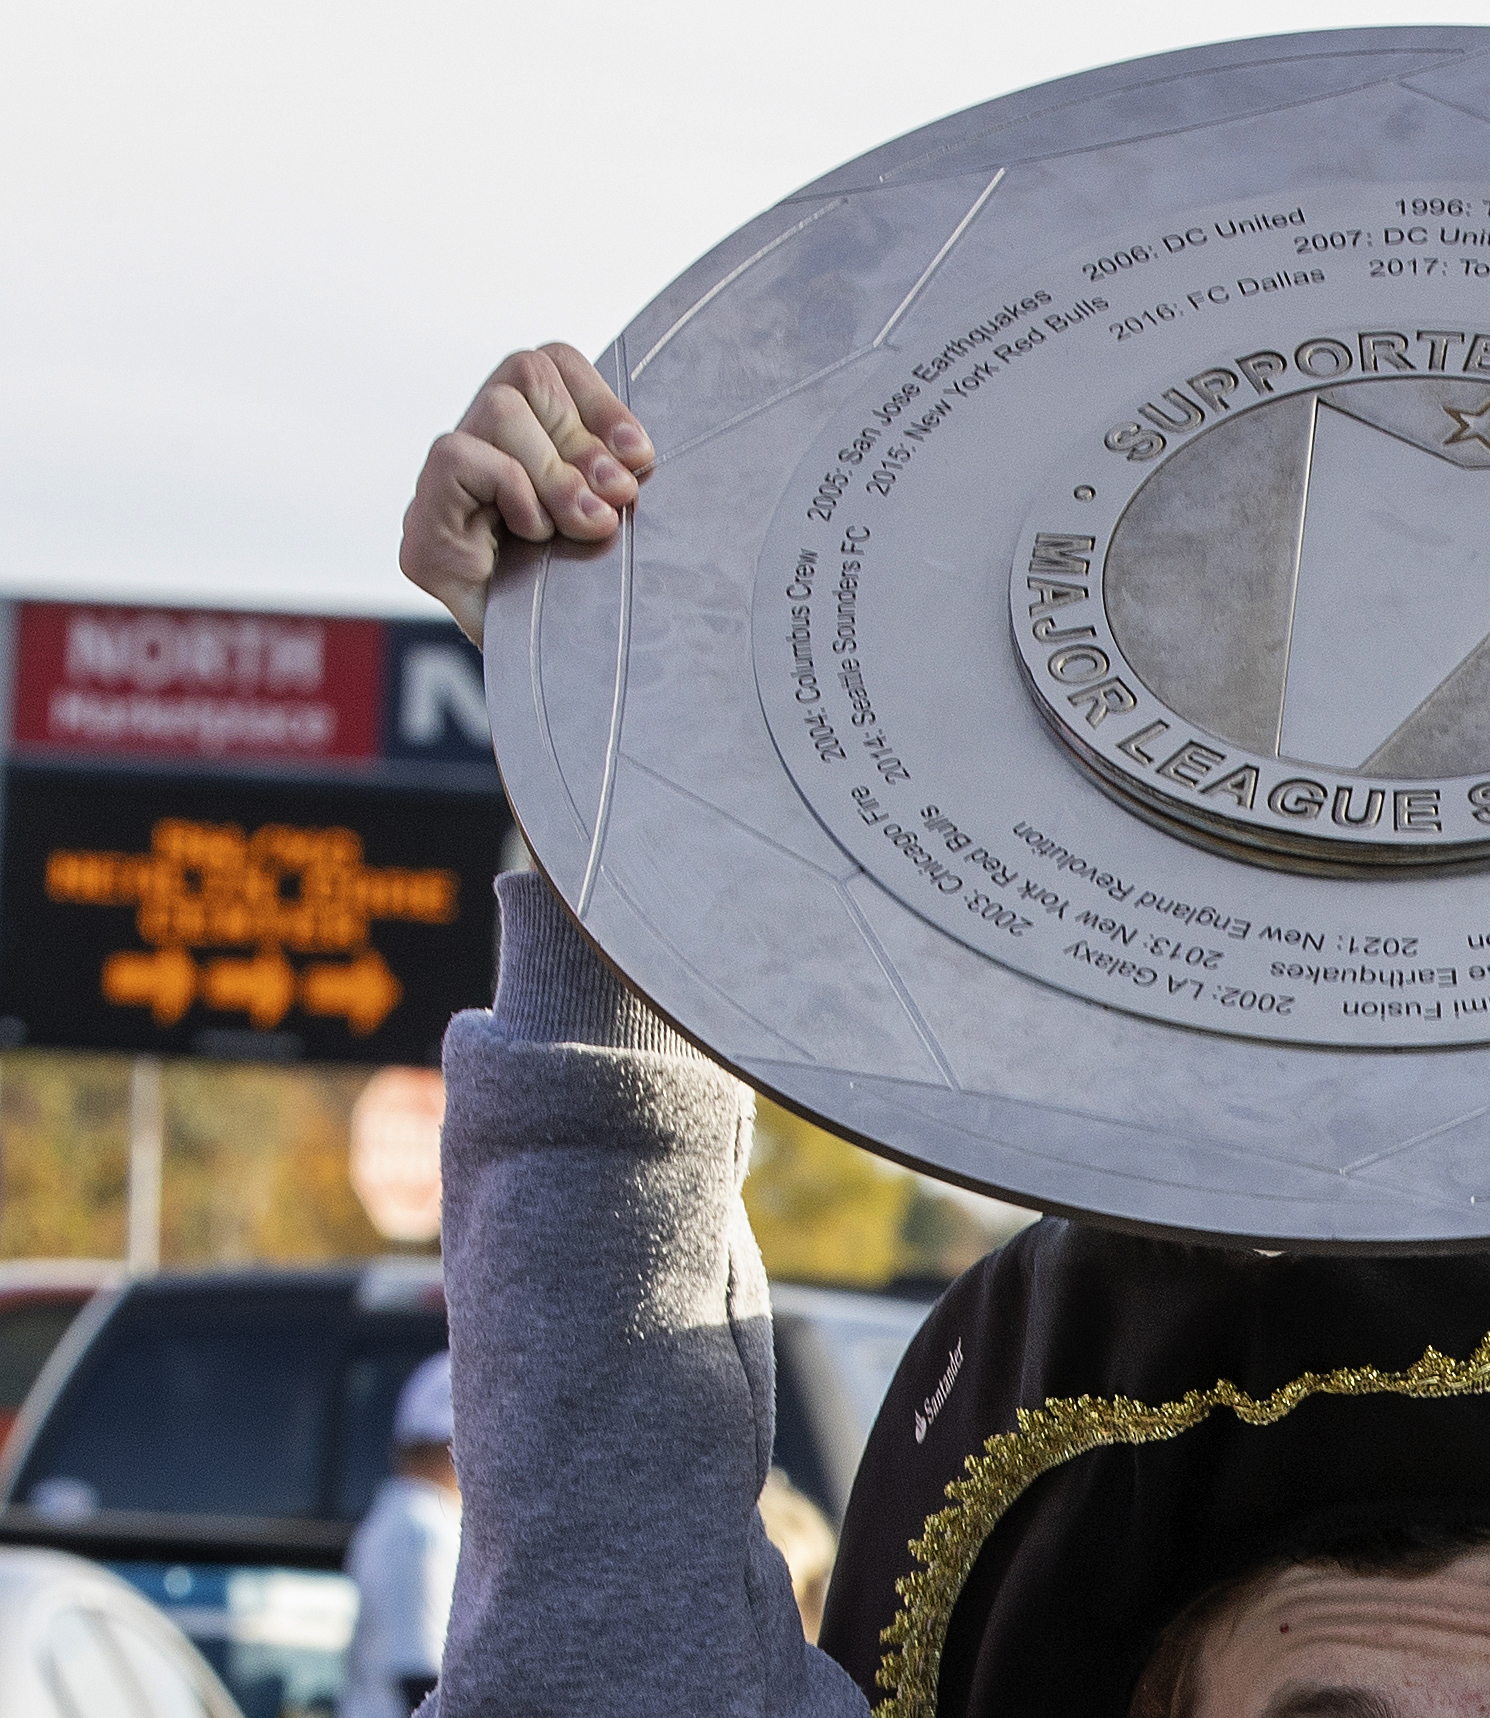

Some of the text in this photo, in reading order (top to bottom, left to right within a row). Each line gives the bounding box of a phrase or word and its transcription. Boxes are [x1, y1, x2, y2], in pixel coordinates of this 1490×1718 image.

[1028, 531, 1137, 725] MAJOR
[1116, 719, 1442, 832] LEAGUE
[922, 1335, 965, 1426] Santander
